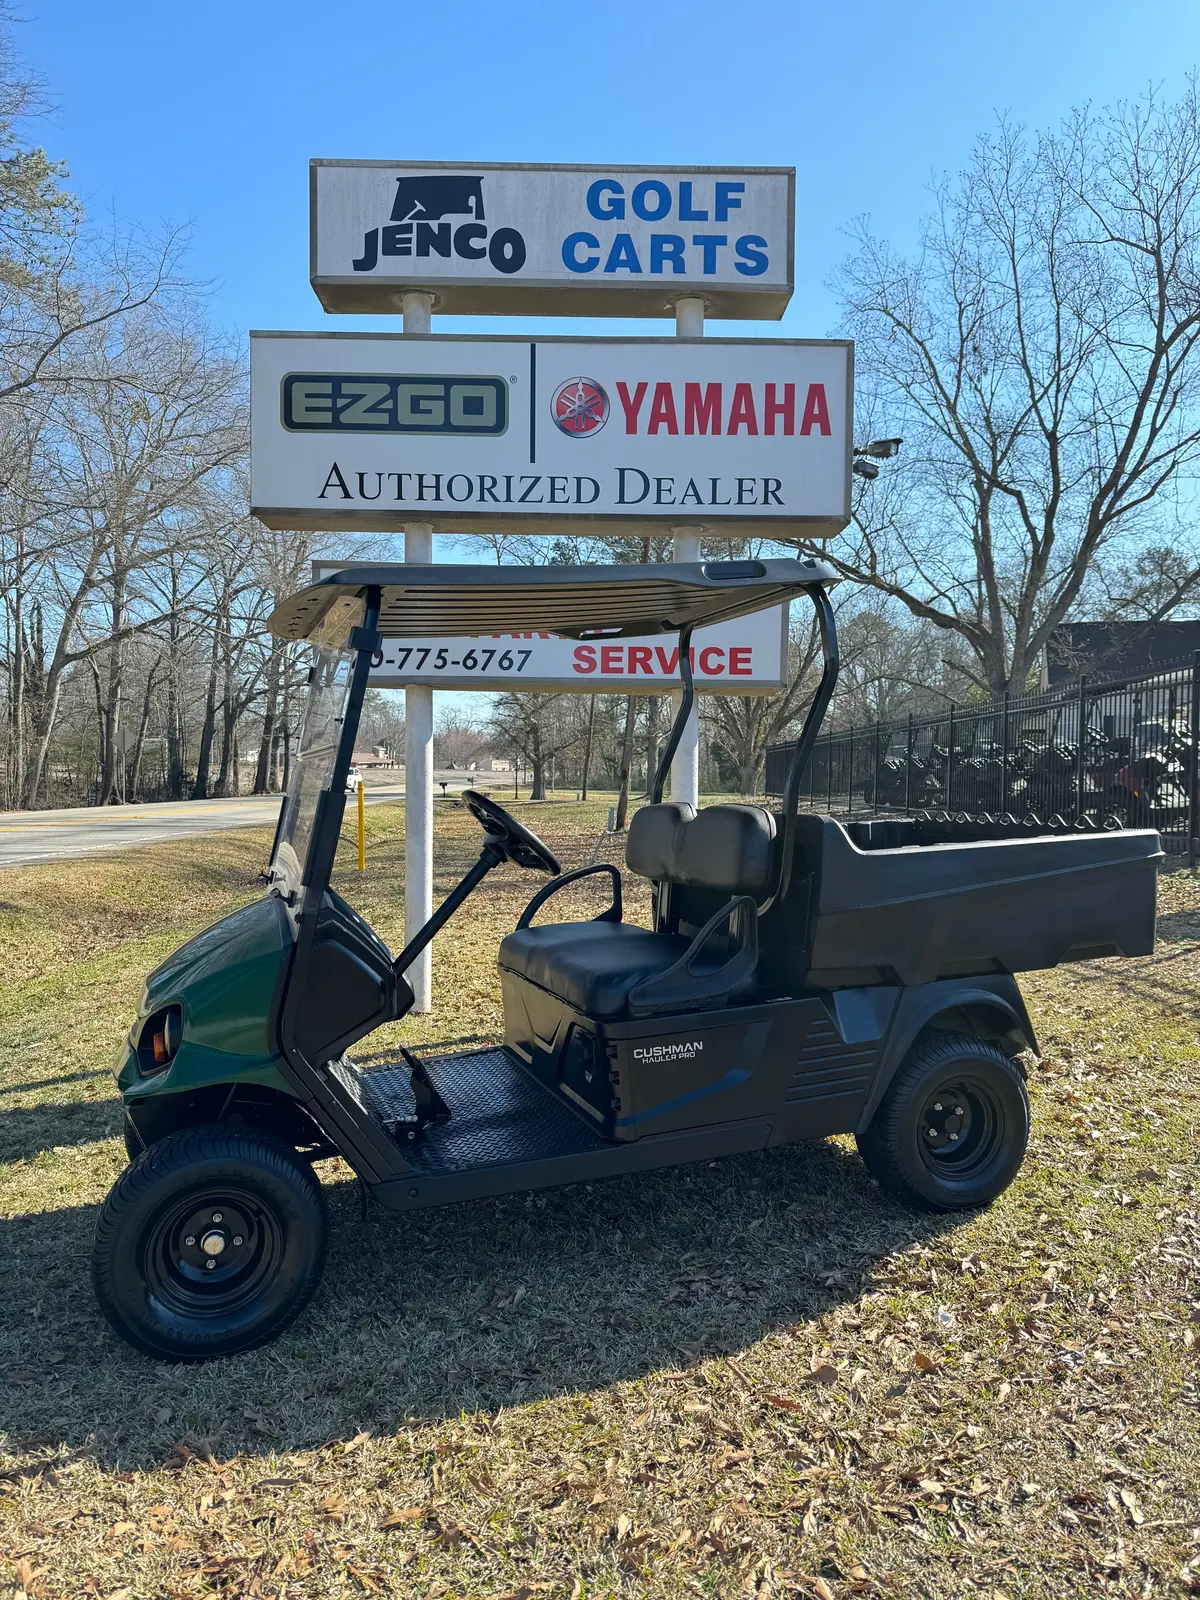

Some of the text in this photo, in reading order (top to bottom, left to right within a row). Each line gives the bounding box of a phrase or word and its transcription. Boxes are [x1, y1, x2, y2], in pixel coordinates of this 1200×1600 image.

[586, 179, 746, 222] GOLF
[353, 222, 526, 274] JENCO
[561, 232, 769, 276] CARTS
[616, 381, 832, 436] YAMAHA
[351, 647, 533, 673] 0-775-6767
[572, 645, 753, 676] SERVICE
[633, 1041, 704, 1059] CUSHMAN
[642, 1051, 696, 1064] HAULER PRO
